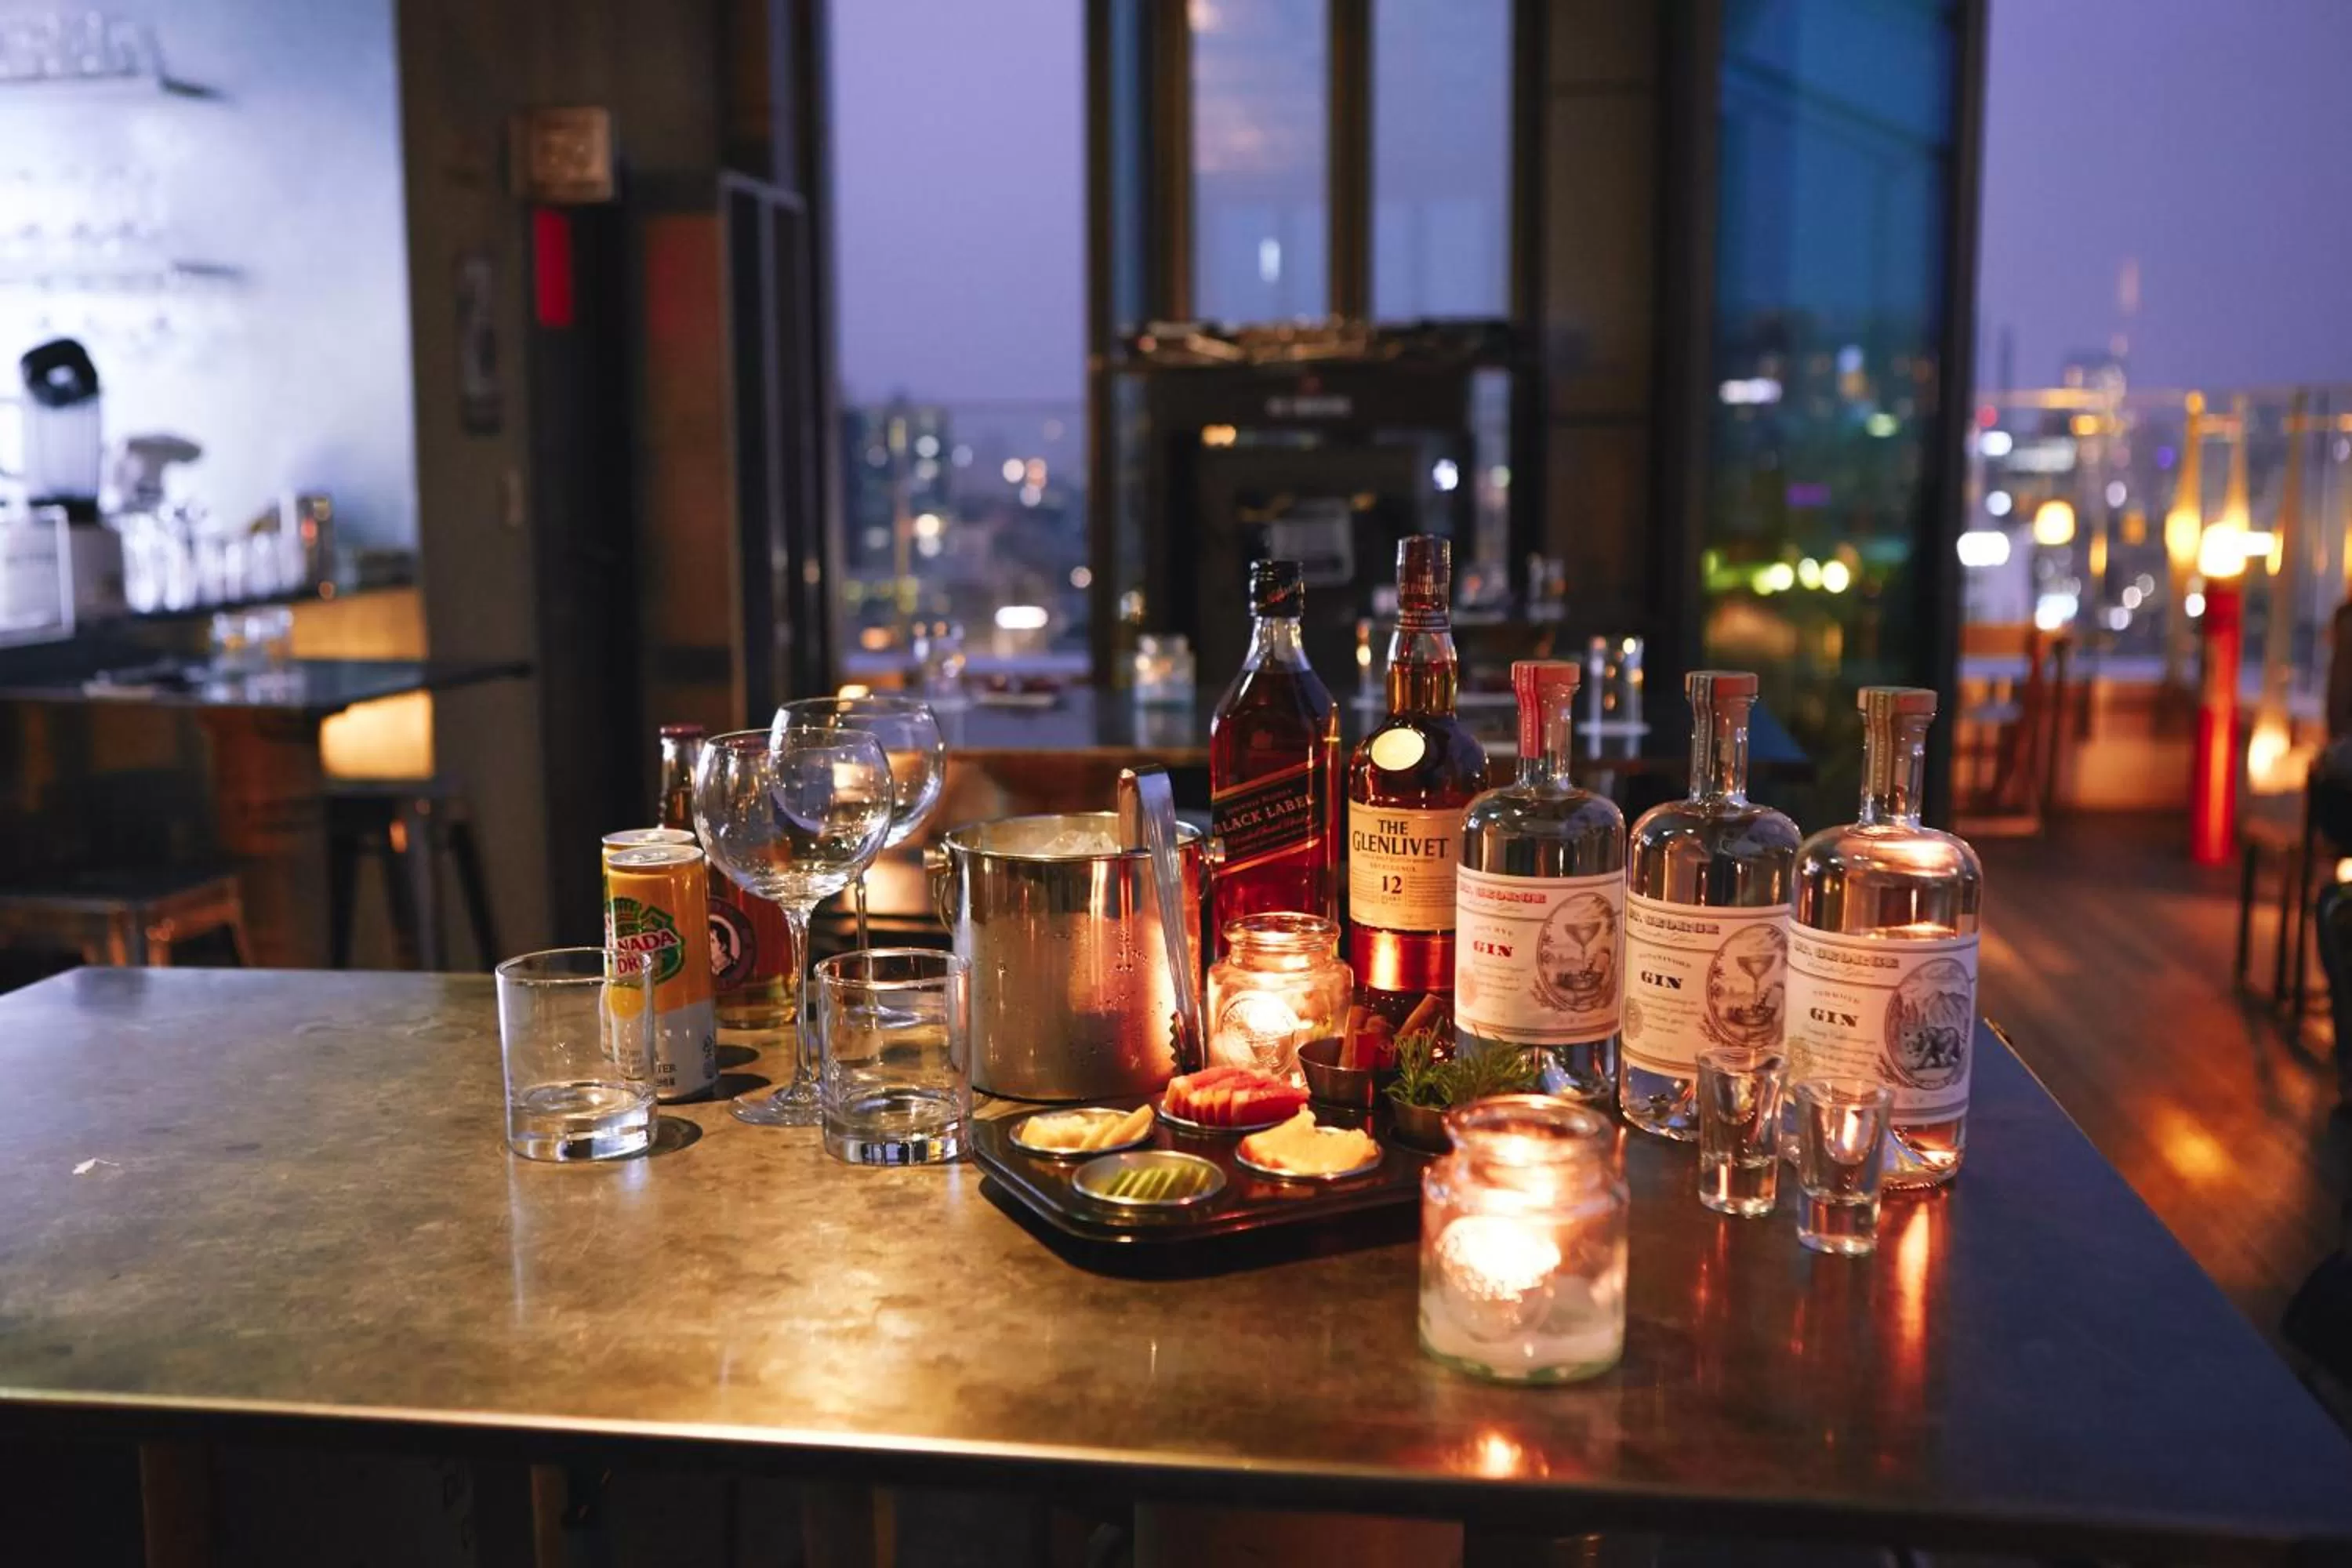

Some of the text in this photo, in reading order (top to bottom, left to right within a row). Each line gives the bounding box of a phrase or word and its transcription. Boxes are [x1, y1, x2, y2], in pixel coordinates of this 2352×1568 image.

[1377, 819, 1408, 835] THE
[1352, 830, 1450, 858] GLENLIVET
[1382, 875, 1402, 894] 12
[1473, 940, 1514, 957] GIN
[1641, 971, 1683, 990] GIN
[1809, 1007, 1859, 1027] GIN
